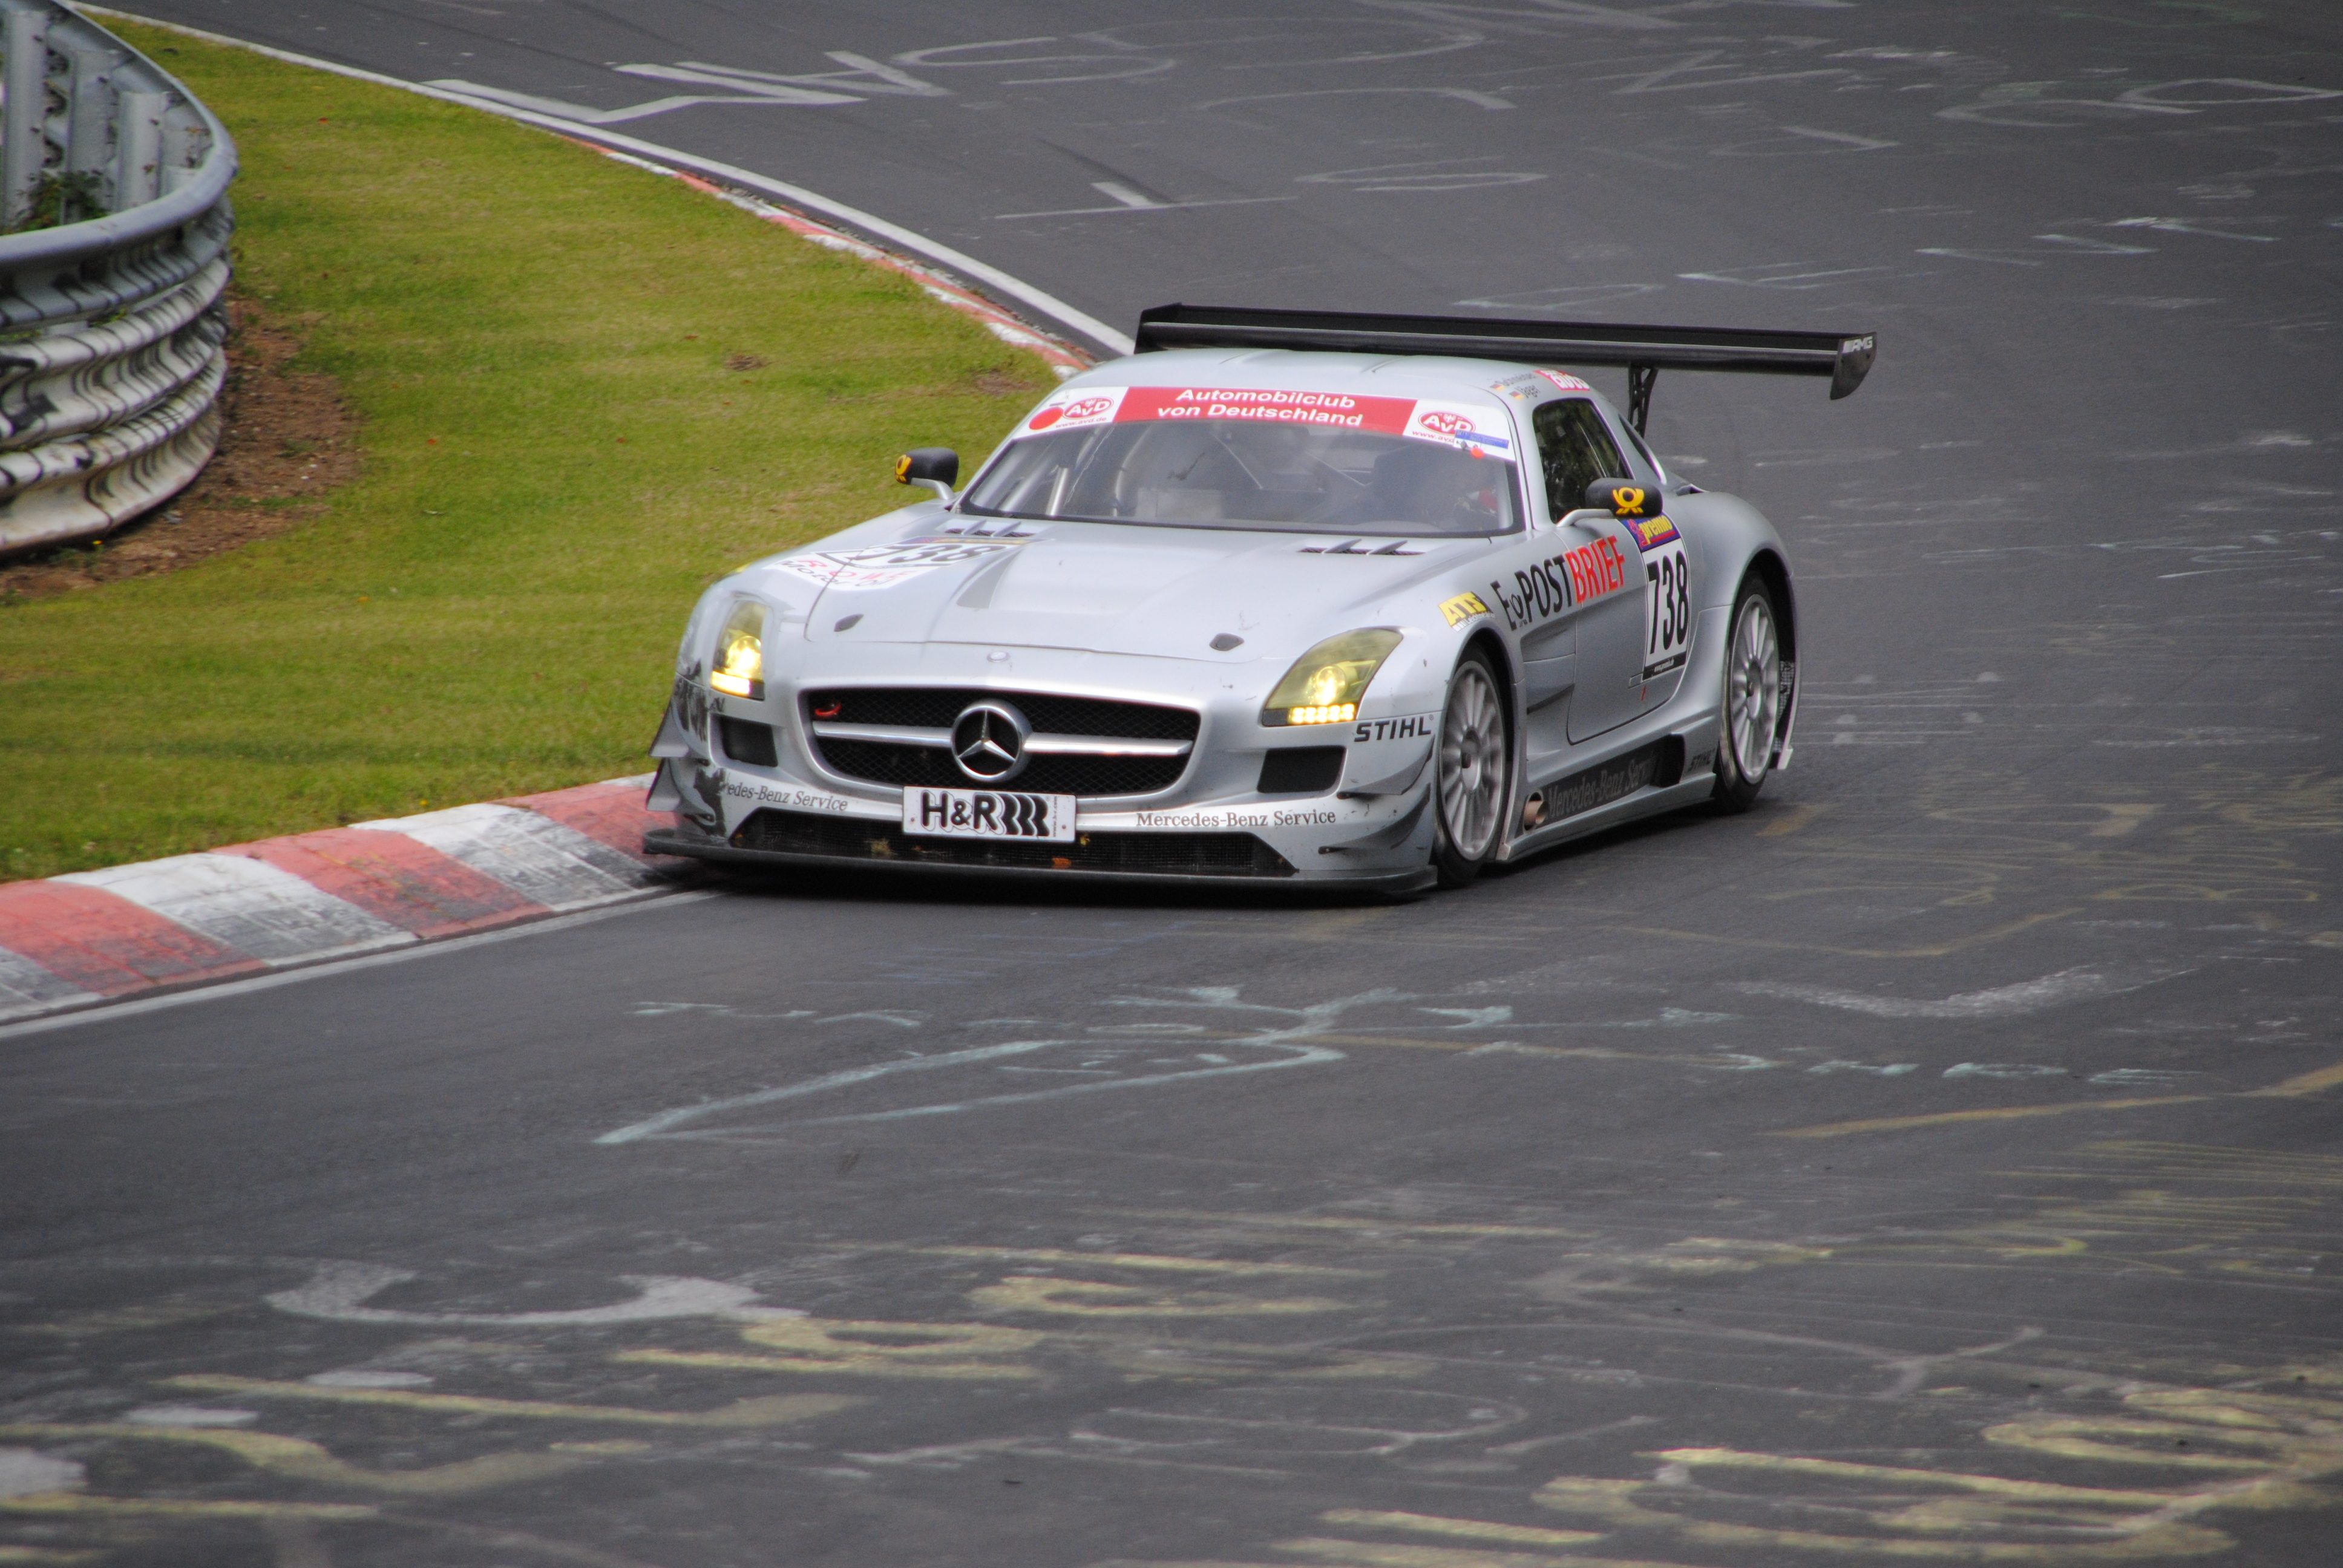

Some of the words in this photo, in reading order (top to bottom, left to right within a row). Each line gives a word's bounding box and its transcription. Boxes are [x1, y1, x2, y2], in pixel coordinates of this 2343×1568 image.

[1847, 336, 1873, 352] AMG
[1066, 400, 1112, 416] AvD
[1176, 390, 1355, 408] Automobilclub
[1158, 406, 1201, 417] von
[1207, 403, 1363, 426] Deutschland
[1423, 414, 1472, 432] AvD
[1646, 550, 1689, 655] 738
[1354, 716, 1432, 742] STIHL
[793, 790, 848, 811] Service
[1136, 811, 1269, 828] Mercedes-Benz
[1273, 809, 1337, 827] Service
